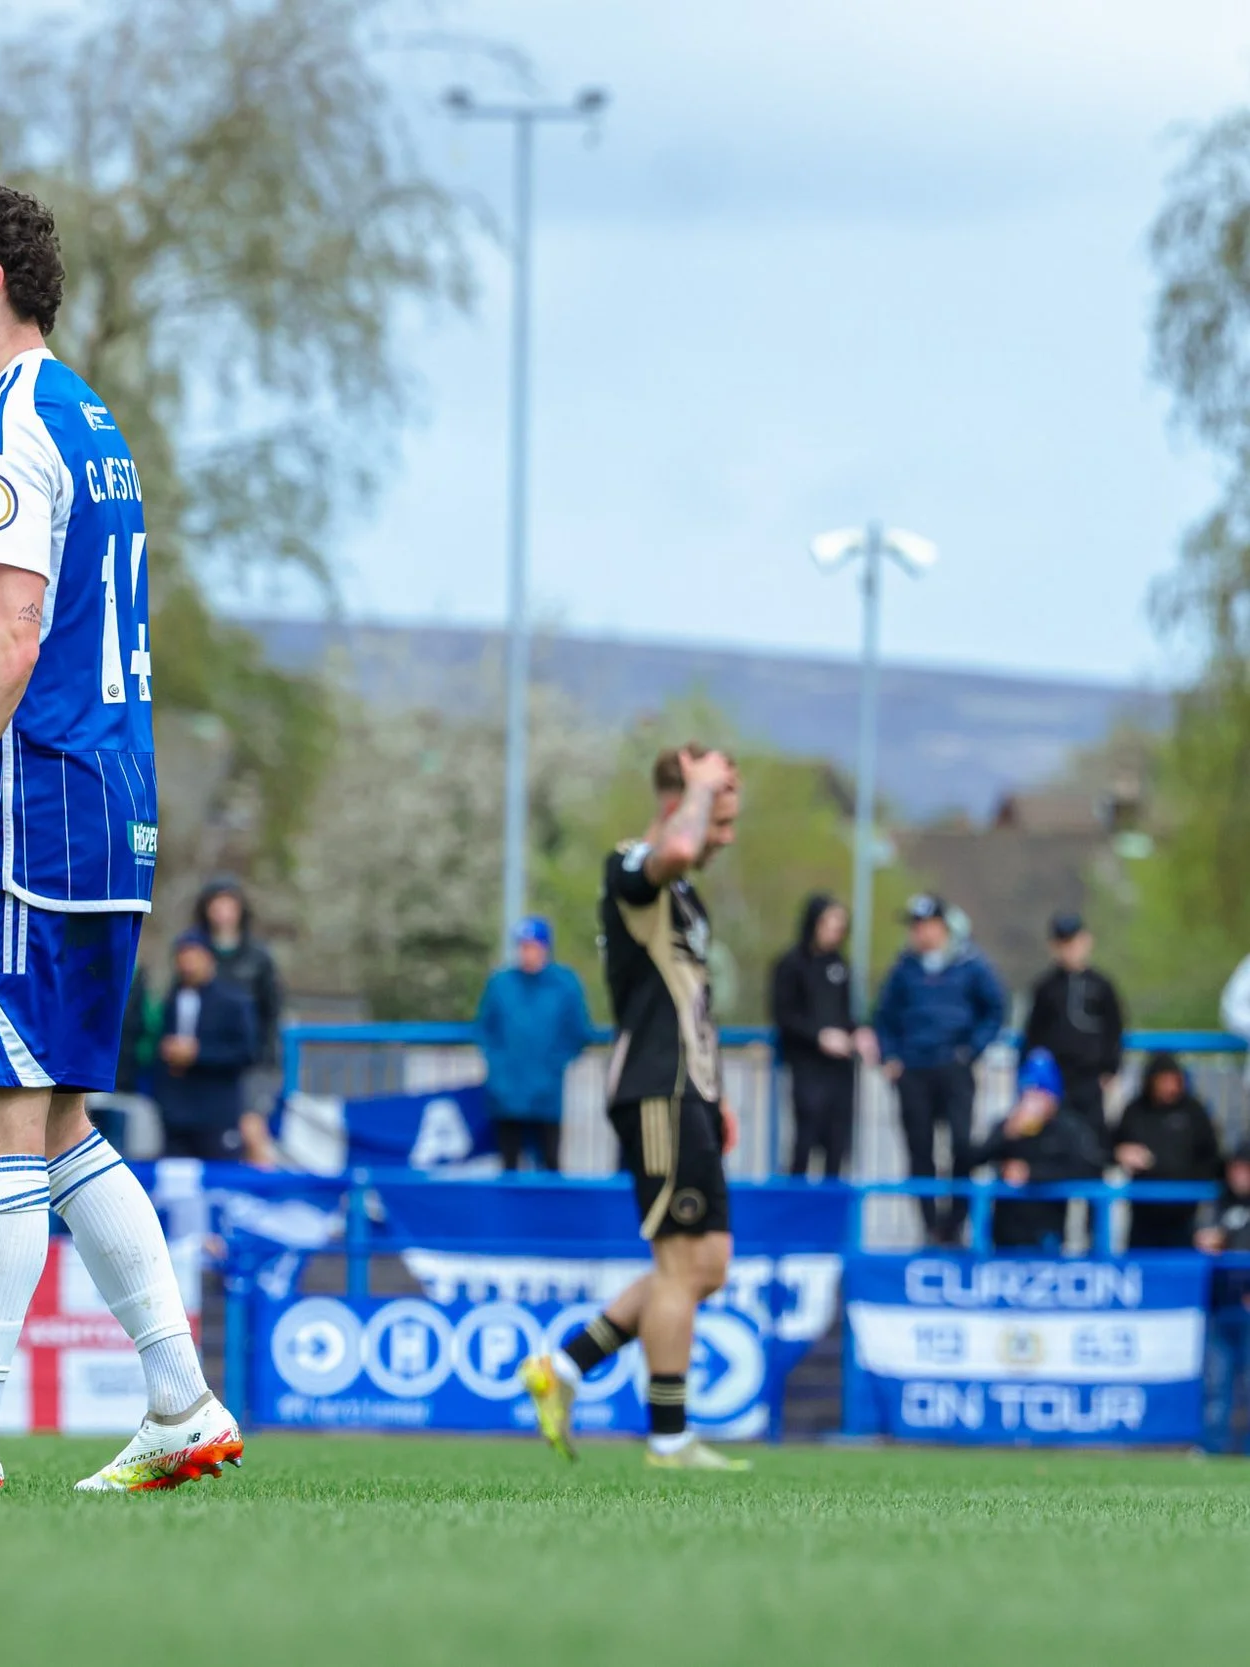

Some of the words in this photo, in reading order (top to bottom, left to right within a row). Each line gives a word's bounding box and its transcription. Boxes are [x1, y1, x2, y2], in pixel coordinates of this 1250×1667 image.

[101, 532, 152, 704] 14
[904, 1258, 1144, 1308] CURZON
[901, 1381, 986, 1430] ON
[988, 1383, 1146, 1432] TOUR
